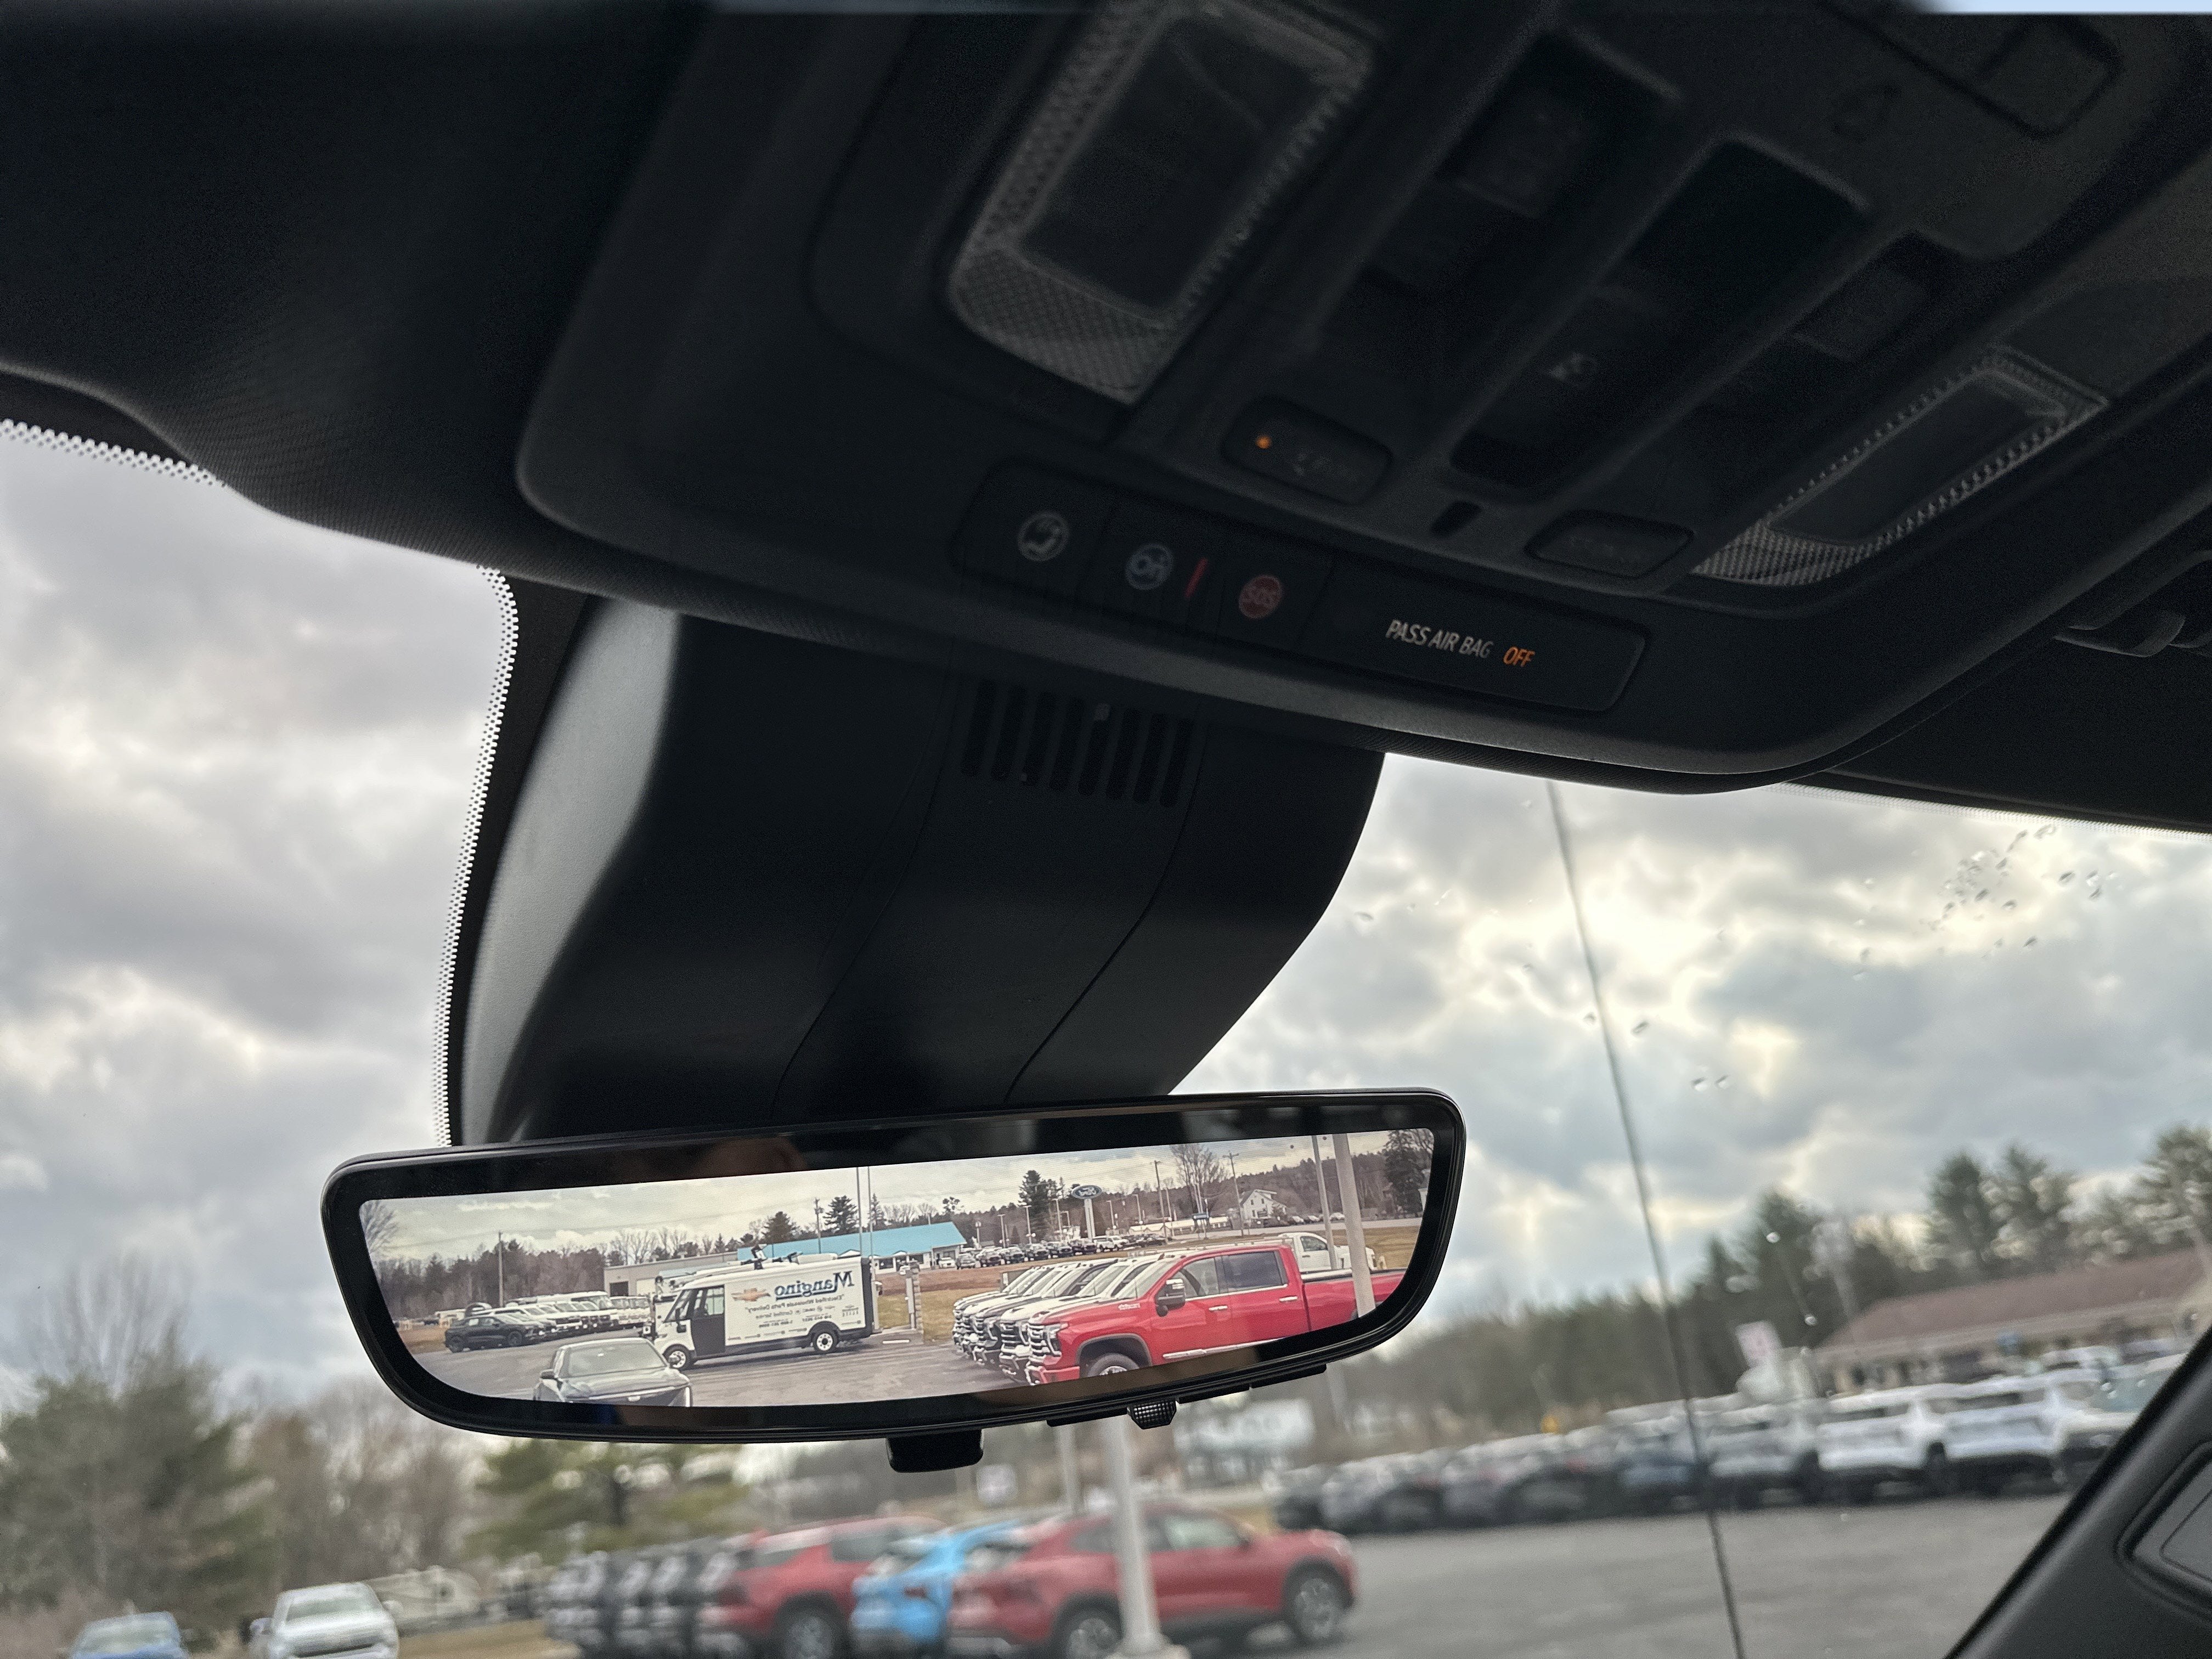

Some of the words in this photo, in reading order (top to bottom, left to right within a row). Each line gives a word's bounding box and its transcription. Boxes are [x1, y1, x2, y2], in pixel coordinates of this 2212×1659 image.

[1386, 619, 1430, 645] PASS
[1429, 629, 1459, 652] AIR
[1459, 636, 1494, 658] BAG
[1503, 646, 1536, 667] OFF
